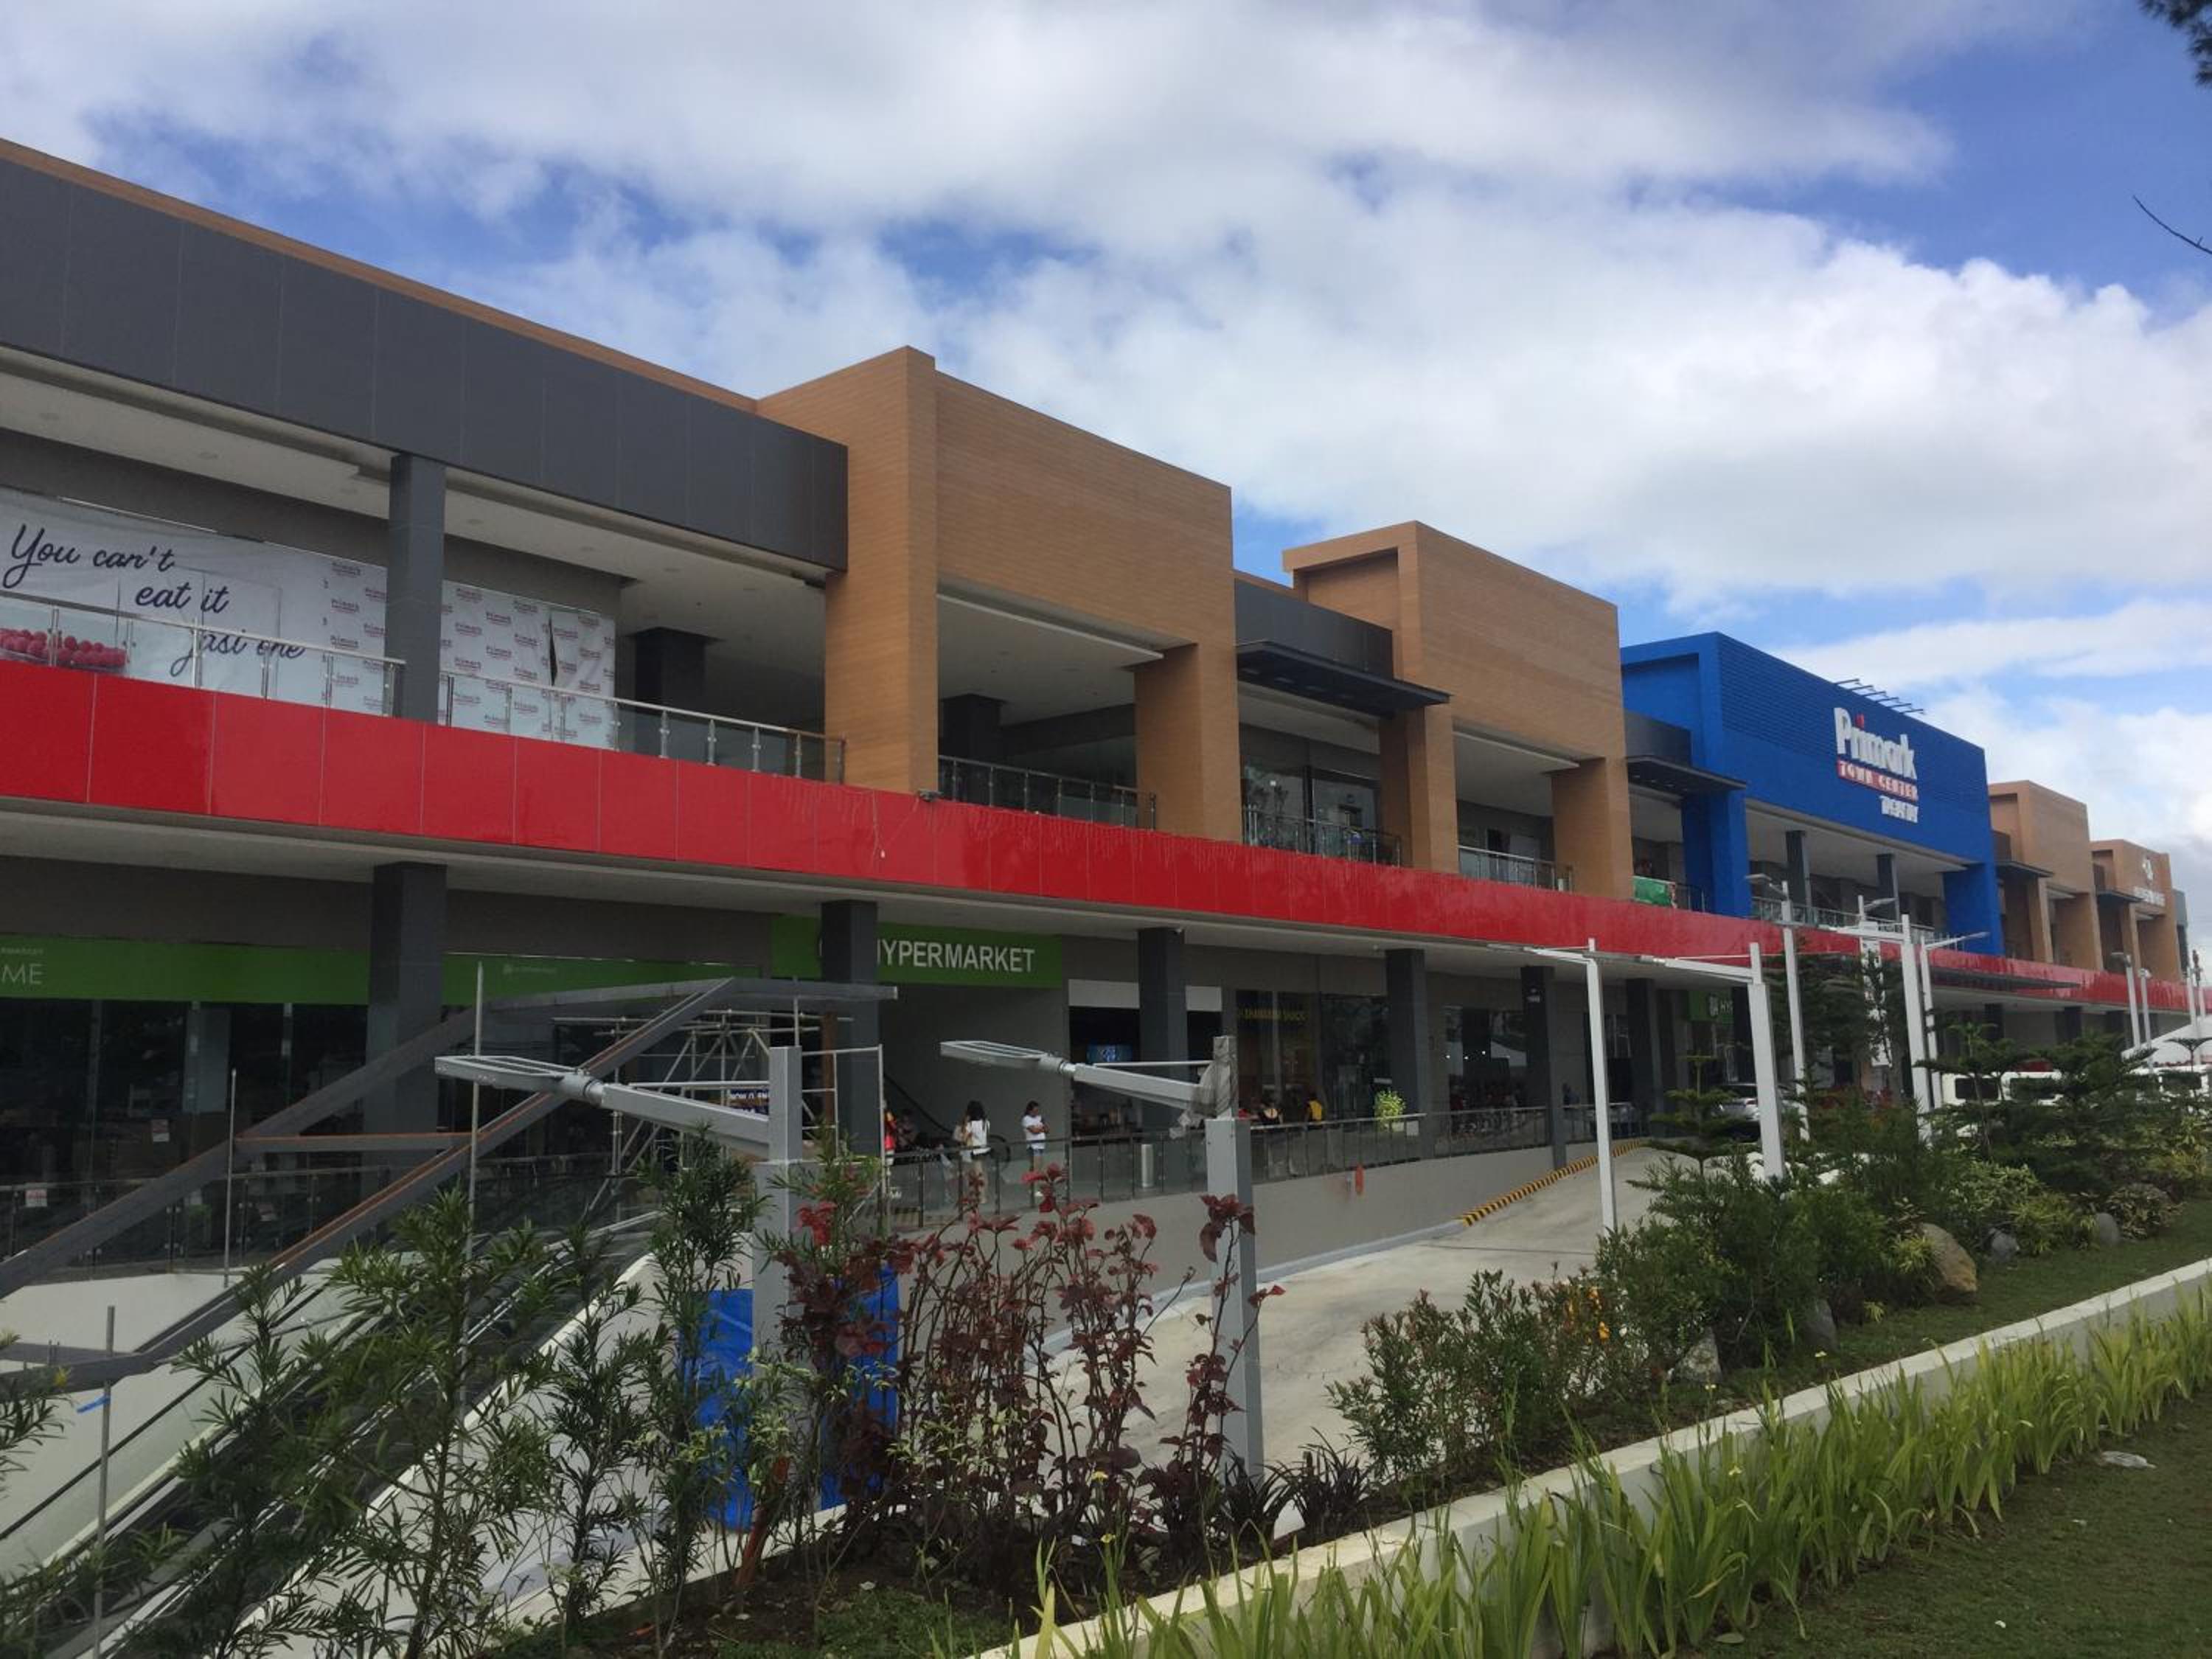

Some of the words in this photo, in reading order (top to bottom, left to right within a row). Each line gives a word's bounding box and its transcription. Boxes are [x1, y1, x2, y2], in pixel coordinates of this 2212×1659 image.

[3, 524, 80, 588] You
[93, 546, 175, 571] can't
[136, 582, 192, 608] eat
[201, 585, 229, 613] it
[877, 939, 1034, 972] YPERMARKET
